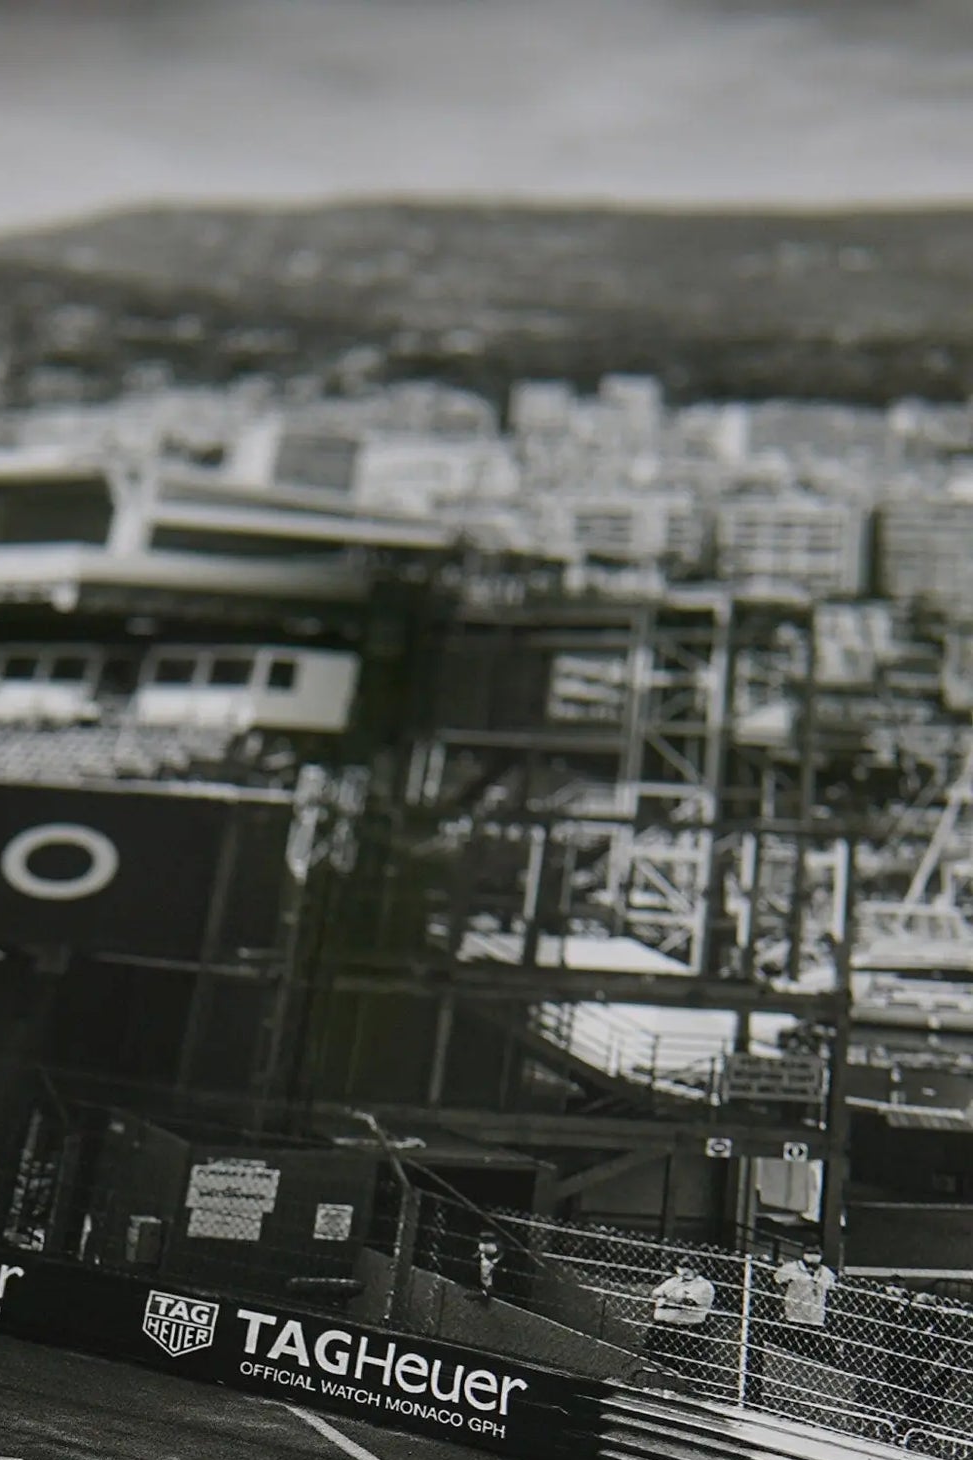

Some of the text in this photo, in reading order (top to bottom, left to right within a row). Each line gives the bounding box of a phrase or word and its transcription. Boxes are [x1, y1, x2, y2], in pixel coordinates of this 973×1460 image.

[154, 1295, 211, 1325] TAG
[147, 1317, 209, 1352] HEUER
[239, 1360, 506, 1440] OFFICIAL WATCH MONACO GPH
